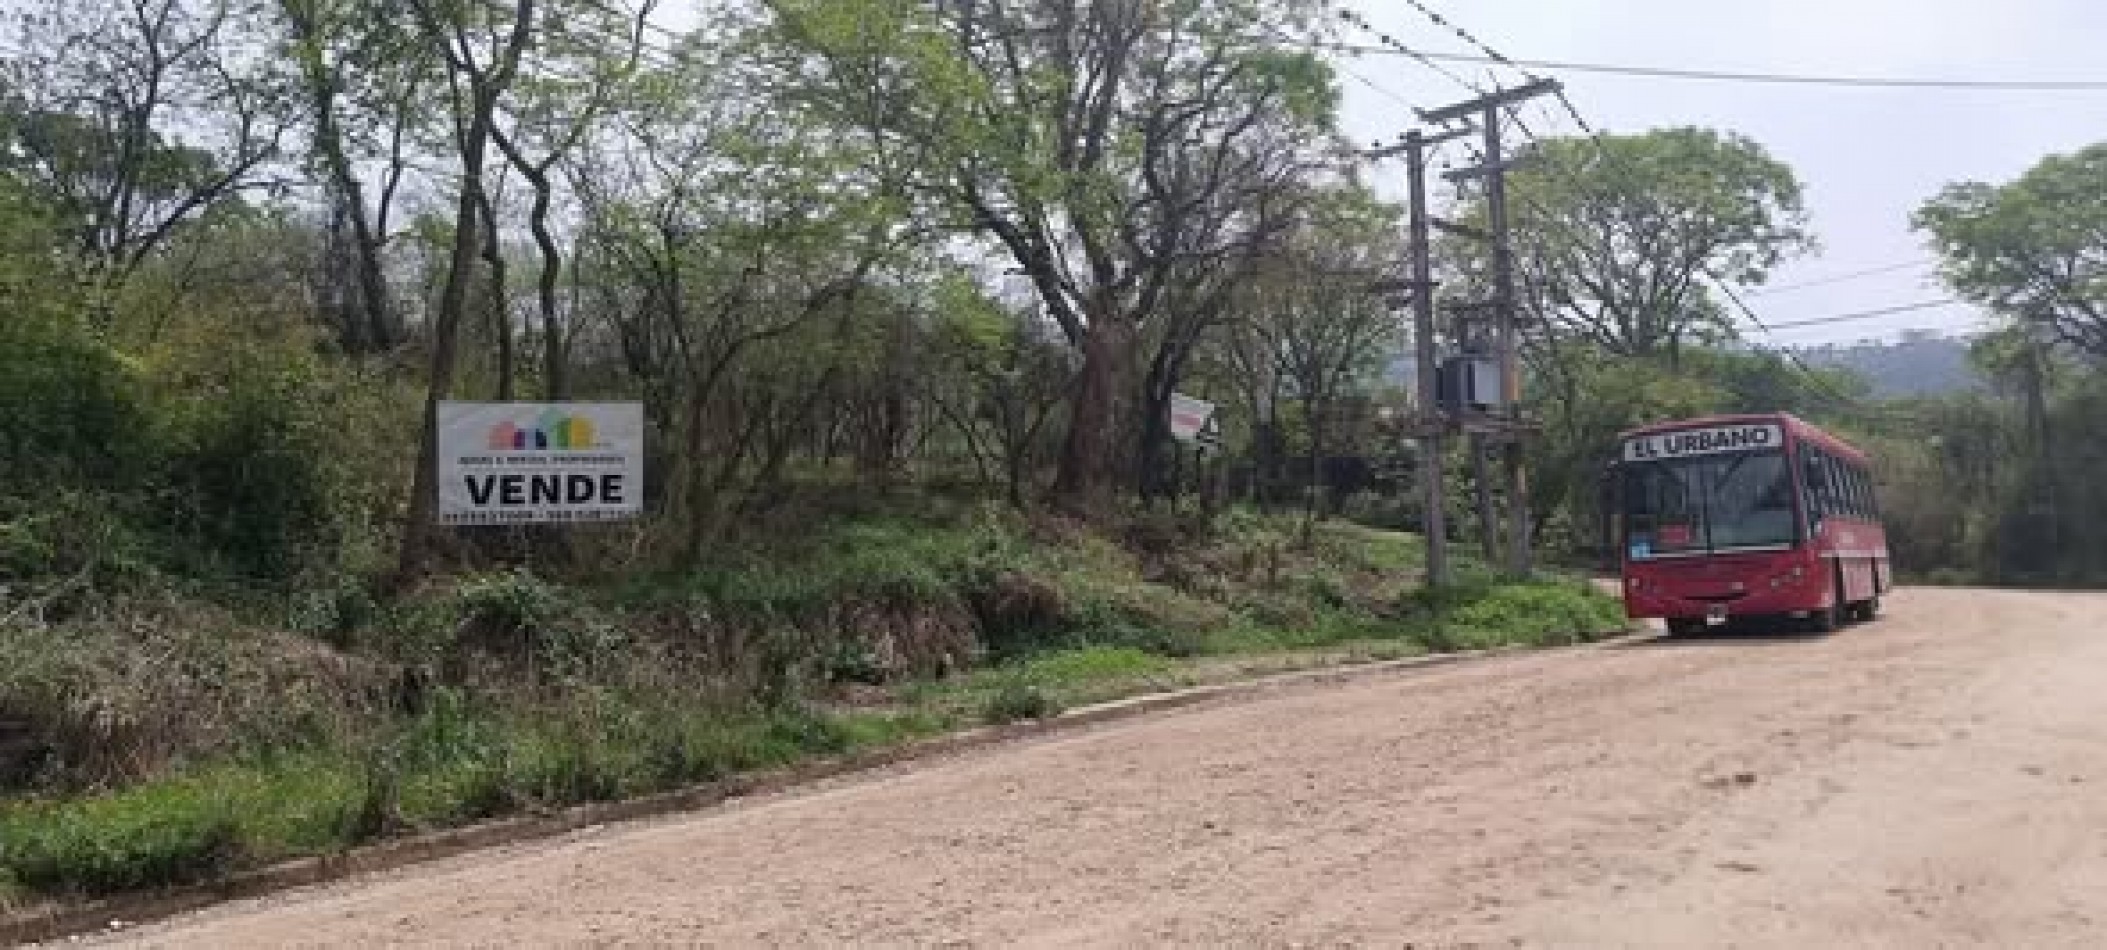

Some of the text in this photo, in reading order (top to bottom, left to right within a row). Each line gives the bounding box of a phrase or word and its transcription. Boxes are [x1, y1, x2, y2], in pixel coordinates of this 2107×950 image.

[1634, 427, 1769, 457] EL URBANO
[464, 475, 623, 505] VENDE
